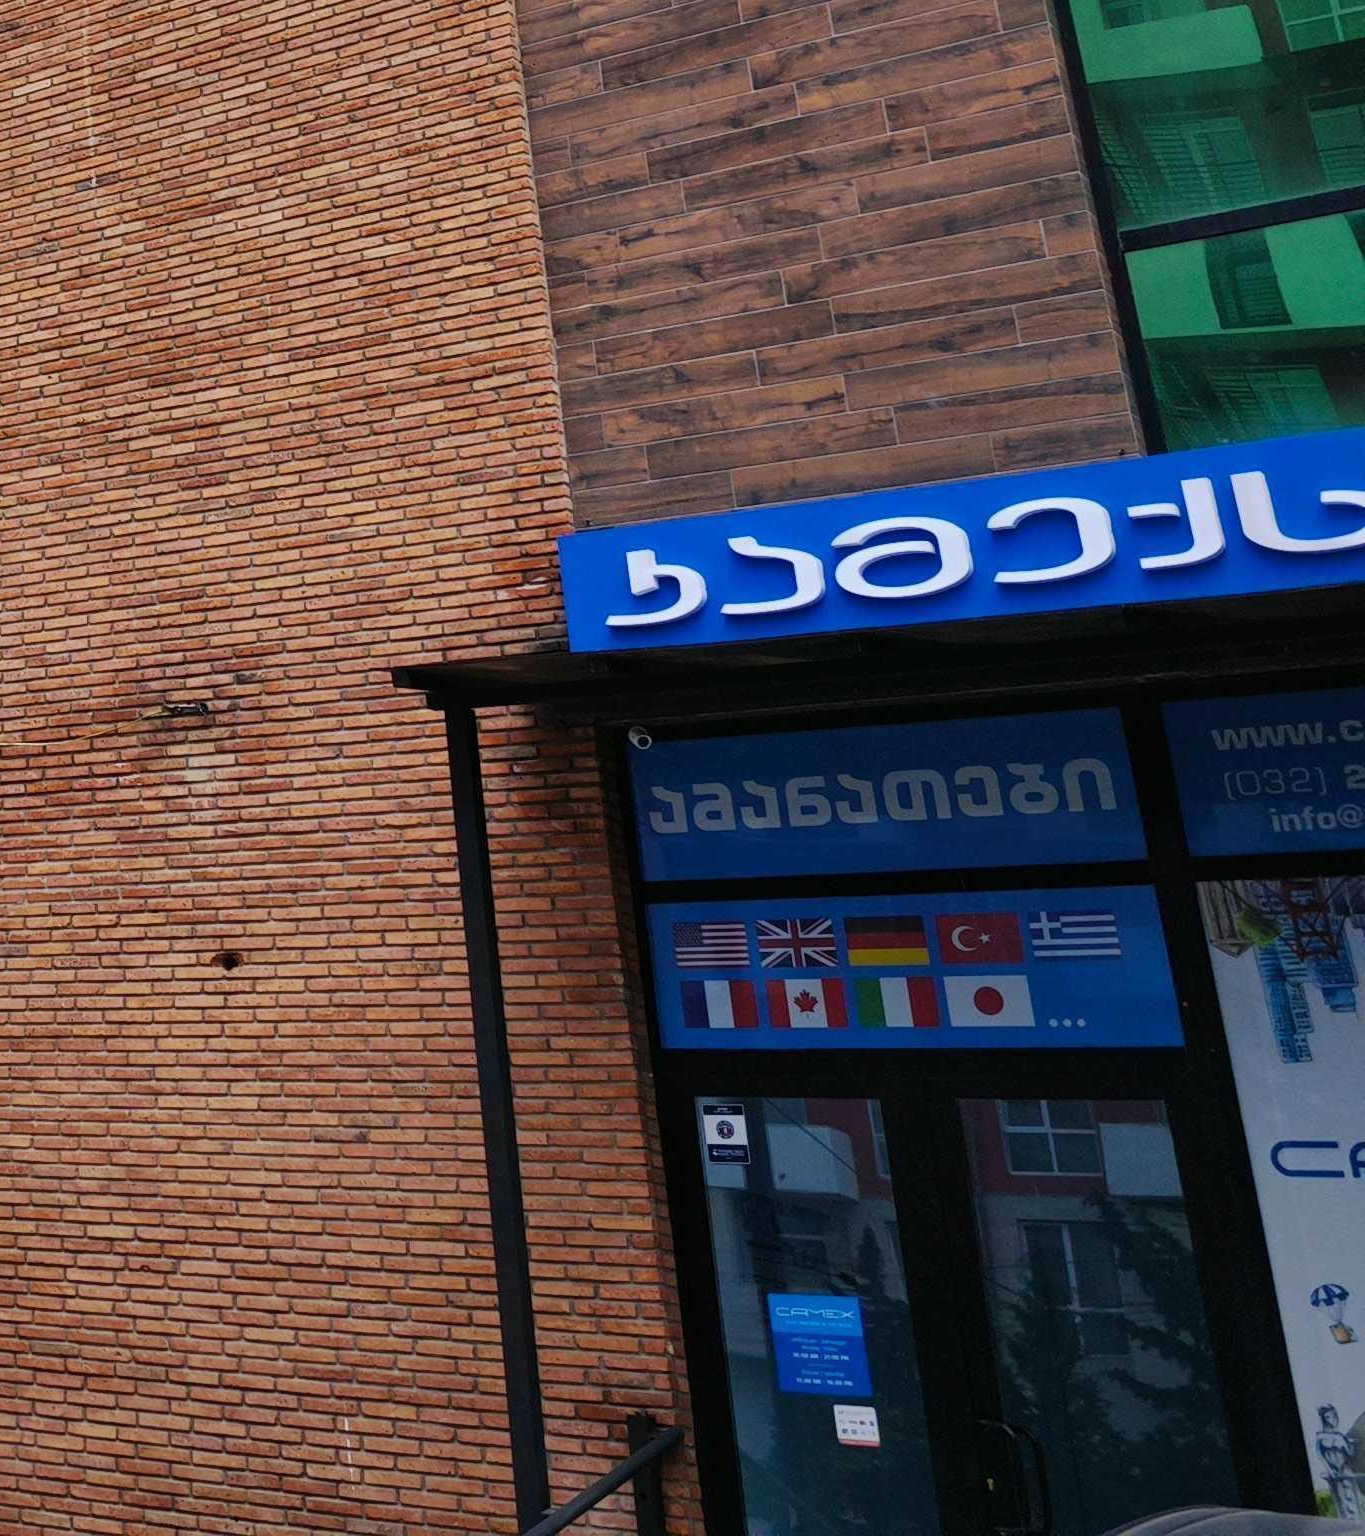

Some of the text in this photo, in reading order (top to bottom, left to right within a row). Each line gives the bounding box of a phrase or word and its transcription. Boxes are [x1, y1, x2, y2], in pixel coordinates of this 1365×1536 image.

[1211, 720, 1365, 751] www.c
[648, 757, 1118, 834] ამანათები
[1224, 764, 1365, 800] (032) 2
[1268, 804, 1365, 833] info@
[775, 1307, 854, 1319] CAMEX
